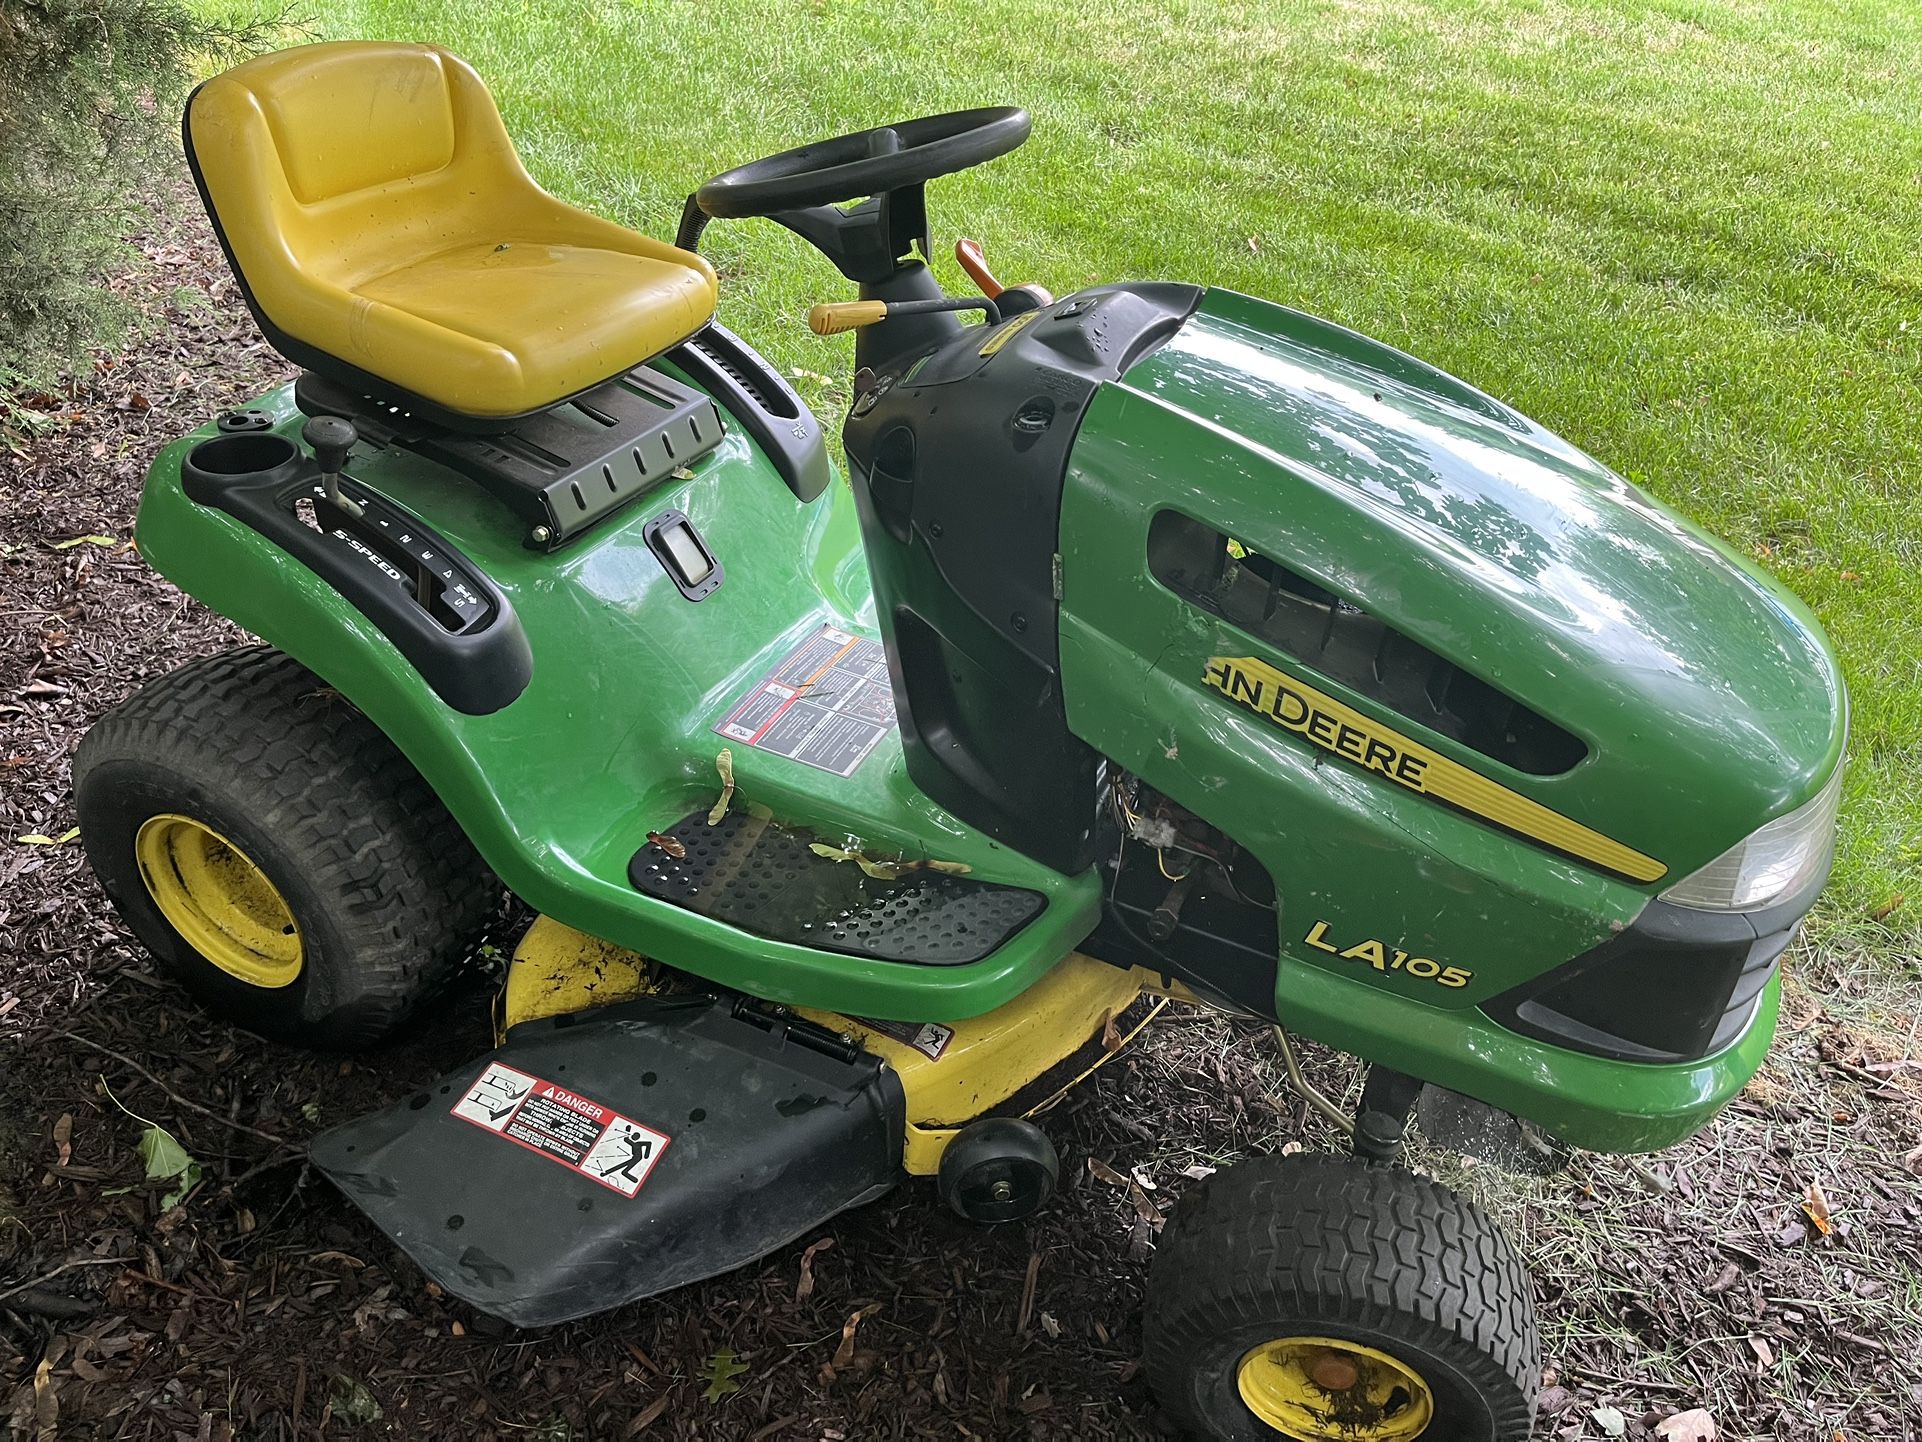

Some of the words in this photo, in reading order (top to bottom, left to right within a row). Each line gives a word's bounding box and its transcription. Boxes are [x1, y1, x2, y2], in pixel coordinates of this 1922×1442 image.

[332, 530, 400, 580] 5-SPEED
[1272, 686, 1428, 787] DEERE
[540, 1098, 571, 1114] ROTATING
[570, 1112, 592, 1124] BLADE
[555, 1090, 604, 1118] DANGER
